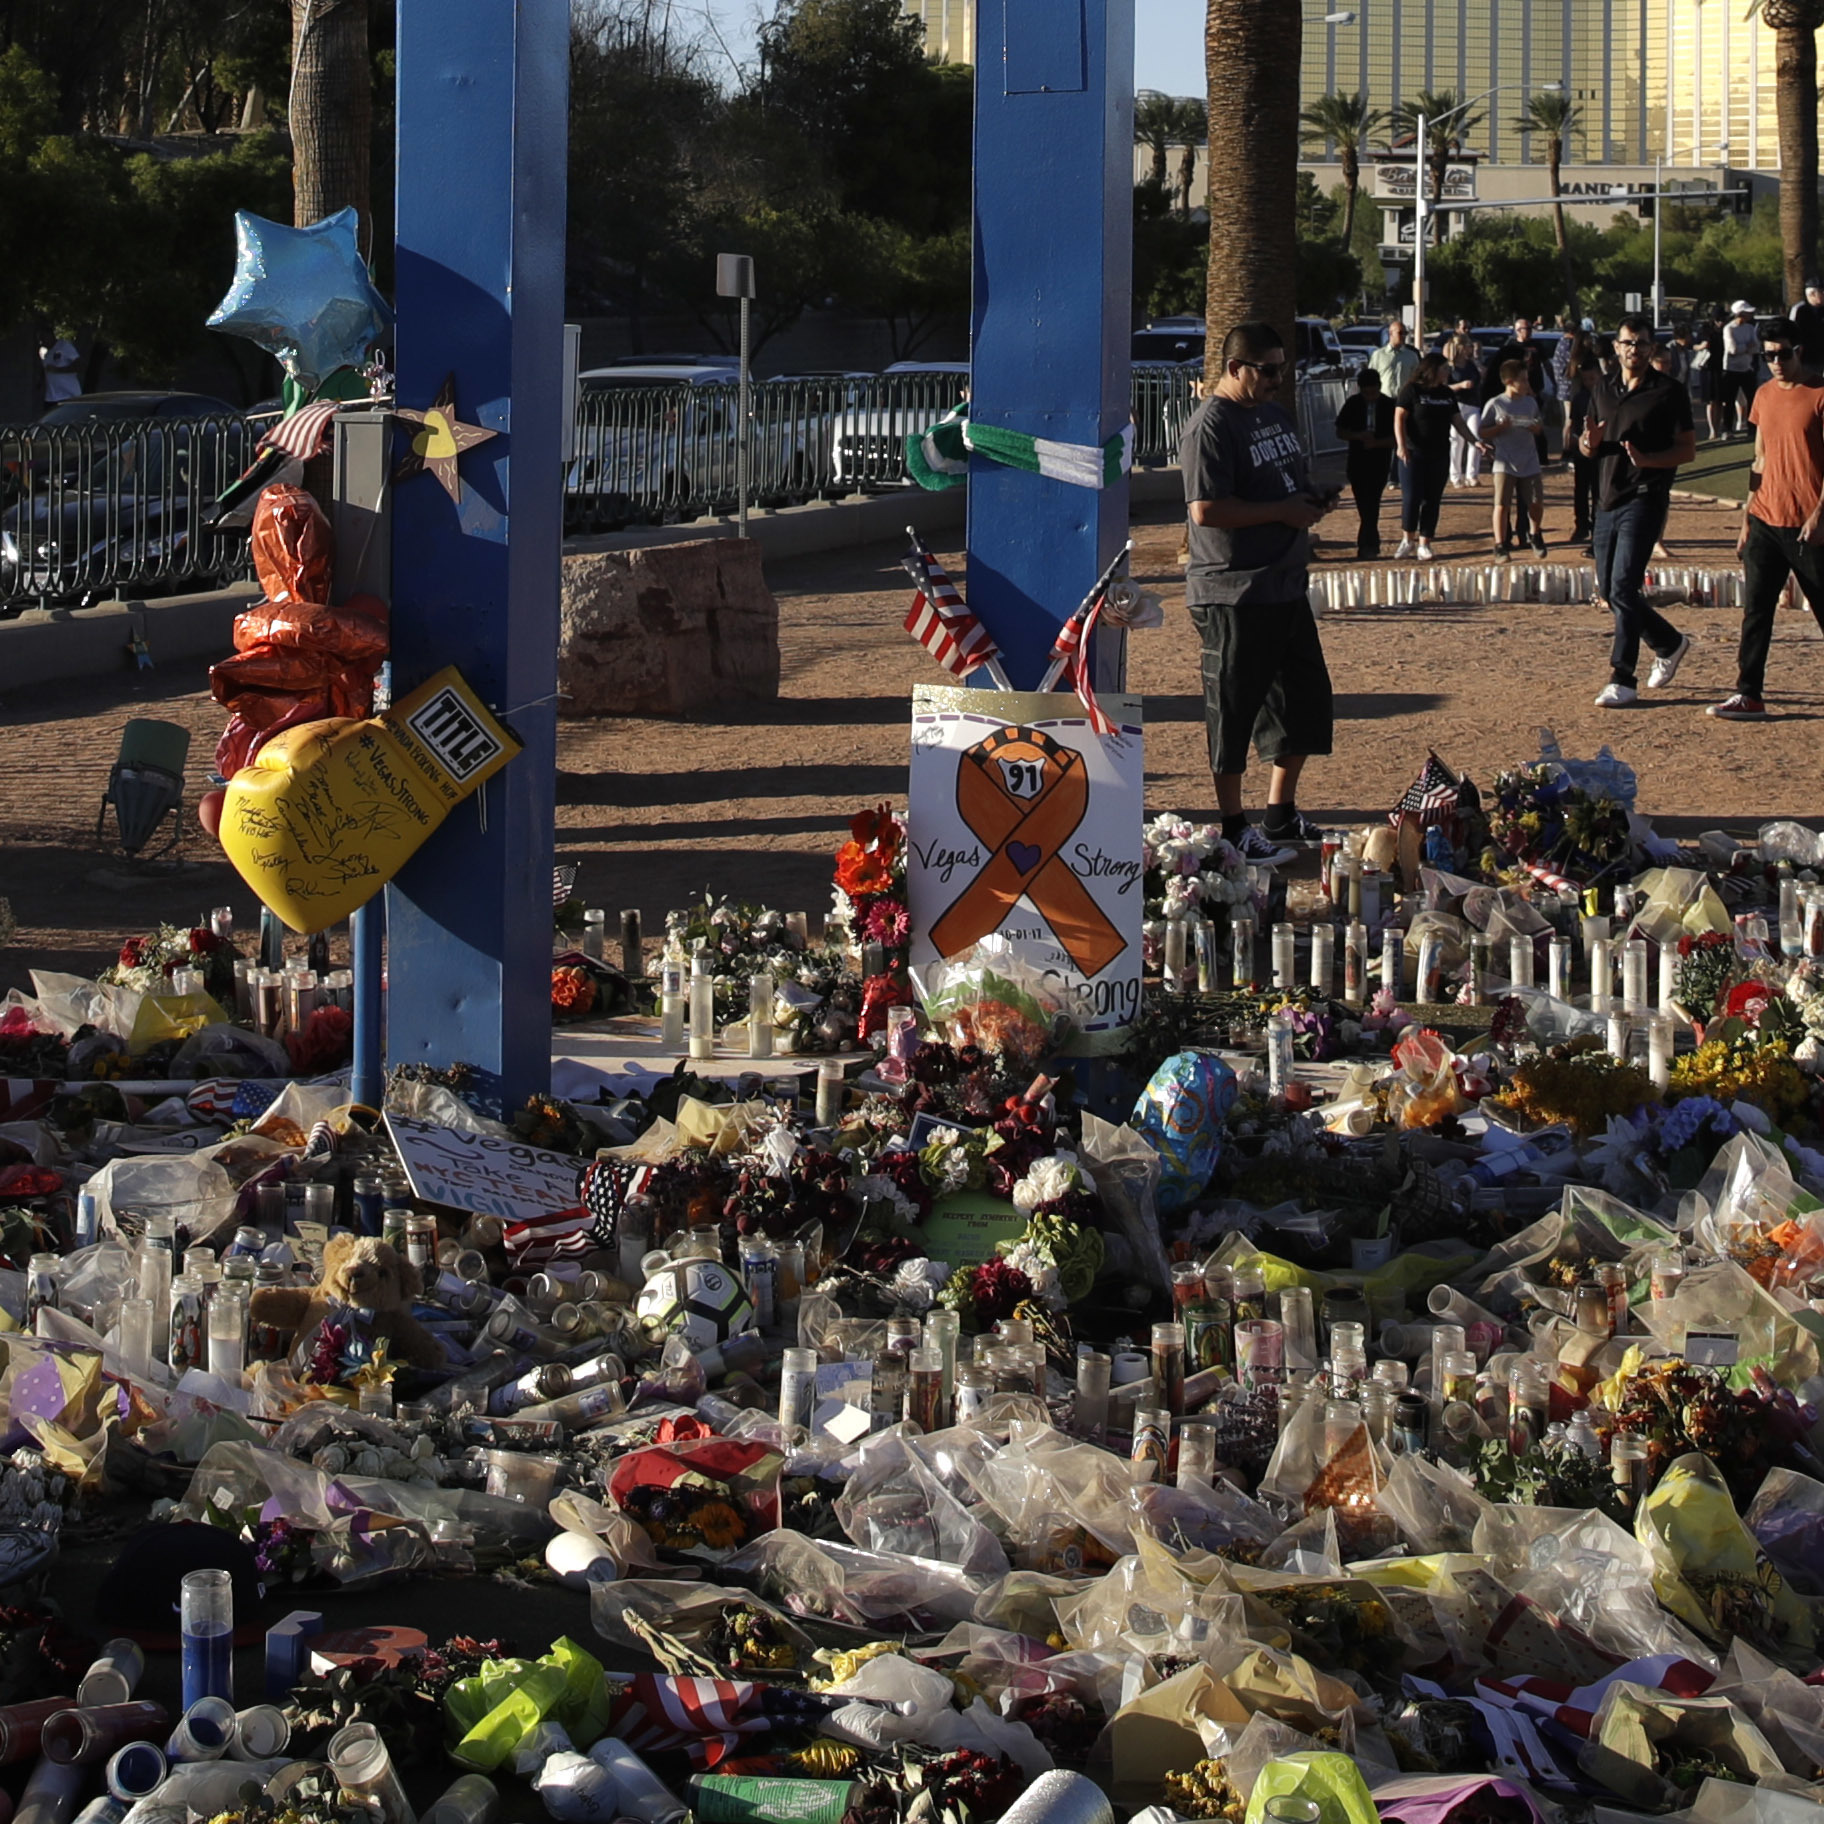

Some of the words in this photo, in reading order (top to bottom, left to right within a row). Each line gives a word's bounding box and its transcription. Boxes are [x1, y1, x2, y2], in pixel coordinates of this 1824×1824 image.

[423, 697, 494, 773] TITLE
[1008, 764, 1037, 793] 91
[911, 838, 980, 884] Vegas
[1070, 843, 1143, 895] Strong
